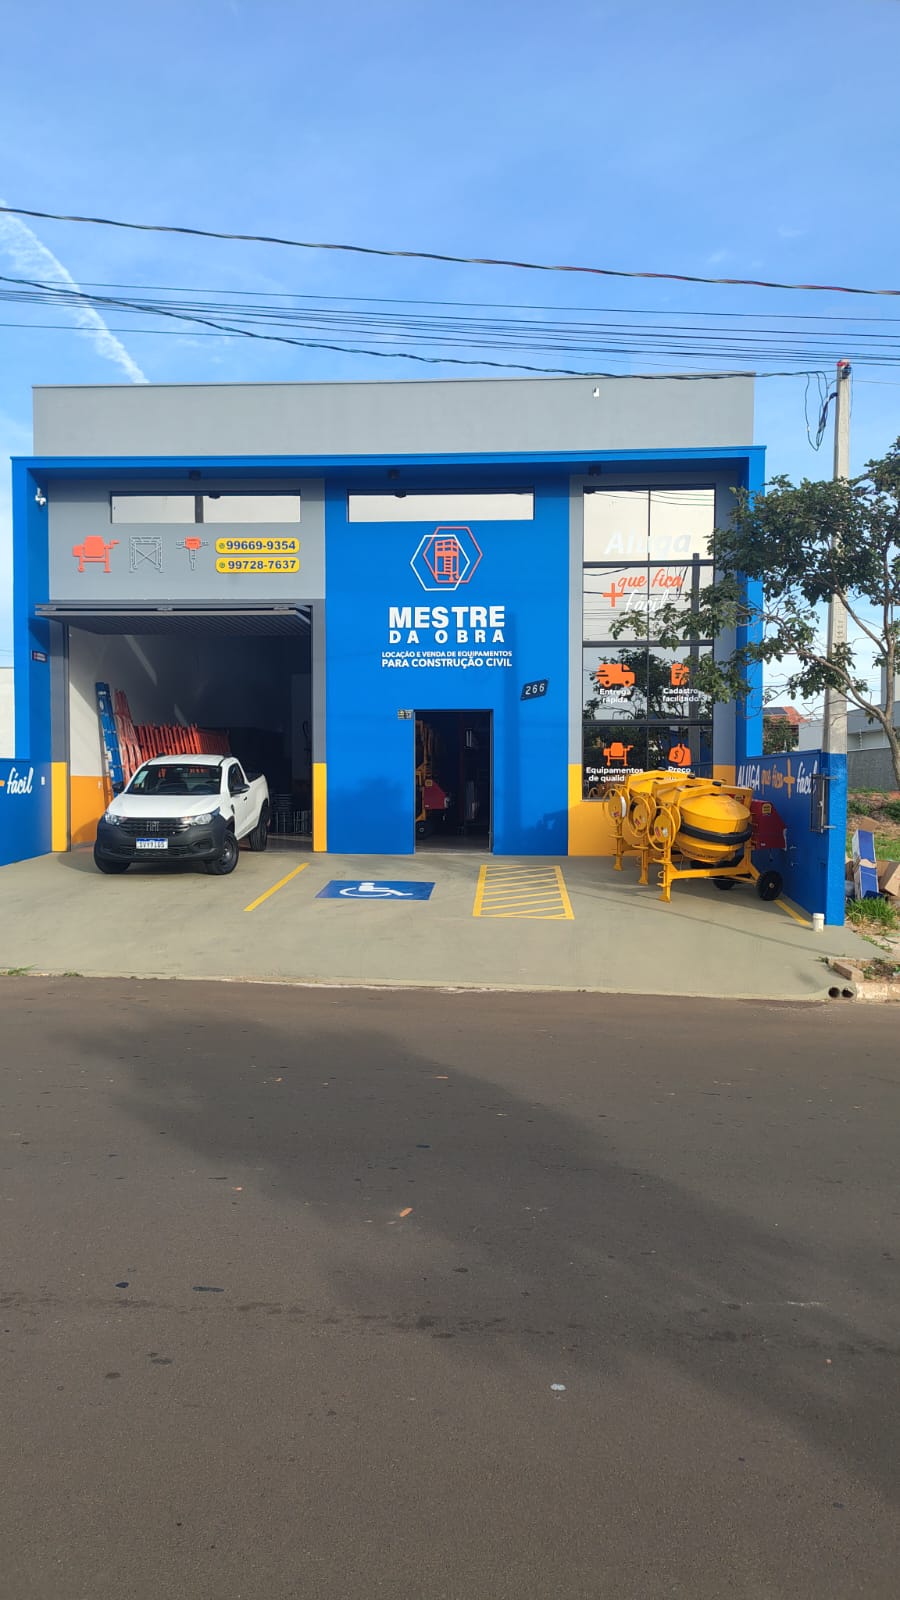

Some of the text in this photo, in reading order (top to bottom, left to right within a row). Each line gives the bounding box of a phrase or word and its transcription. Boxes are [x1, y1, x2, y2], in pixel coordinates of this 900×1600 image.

[226, 541, 296, 550] 99669-9354
[228, 560, 296, 570] 99728-7637
[618, 568, 683, 594] que fica
[389, 606, 505, 628] MESTRE
[389, 629, 505, 644] DA OBRA
[382, 651, 415, 660] LOCAÇÃO
[382, 656, 512, 669] PARA CONSTRUÇÃO CIVIL
[525, 683, 545, 695] 266
[600, 688, 631, 697] Entrega
[586, 767, 644, 775] Equipamentos
[7, 767, 34, 794] fácil
[737, 765, 760, 791] ALUGA
[146, 820, 160, 832] FIAT
